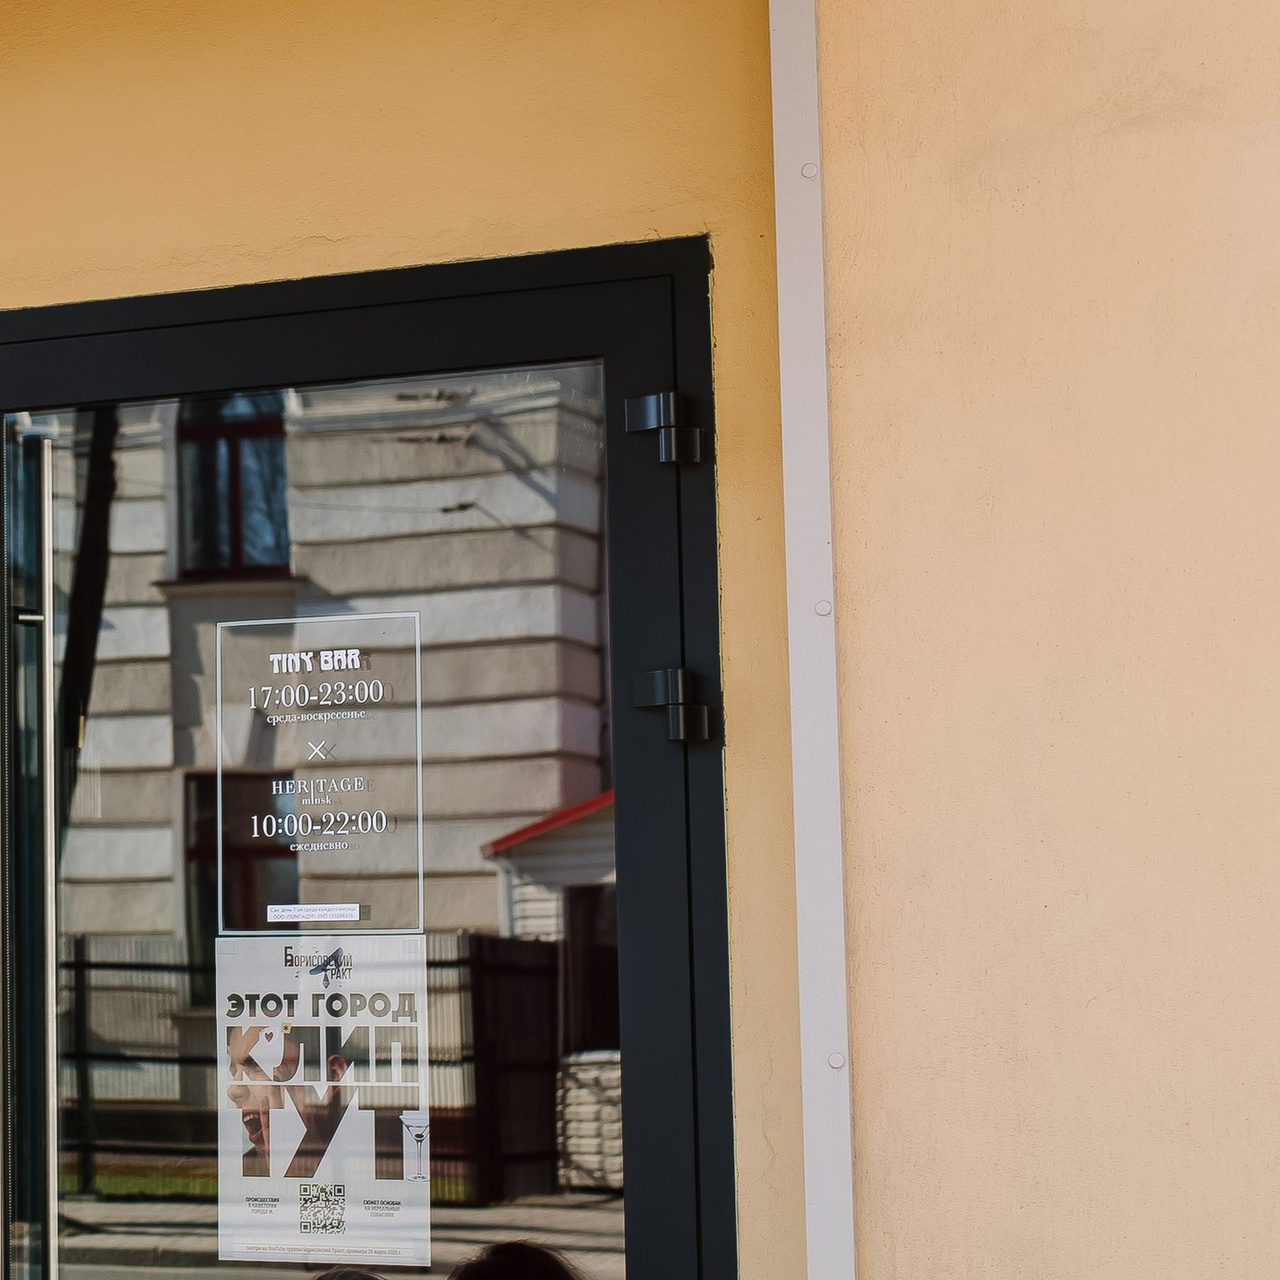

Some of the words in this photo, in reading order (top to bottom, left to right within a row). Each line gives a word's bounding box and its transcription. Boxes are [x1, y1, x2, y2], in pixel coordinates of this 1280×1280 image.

[268, 651, 314, 674] TINY
[319, 648, 361, 671] BAR
[248, 679, 384, 710] 17:00-23:00
[266, 709, 366, 726] среда-воскресенье
[271, 777, 365, 795] HERITAGE
[251, 809, 387, 838] 10:00-22:00
[289, 841, 349, 852] ежедневно
[225, 992, 299, 1019] ЭТОТ
[311, 991, 418, 1023] ГОРОД
[225, 1025, 419, 1083] КЛИП
[226, 1084, 420, 1181] ТУТ
